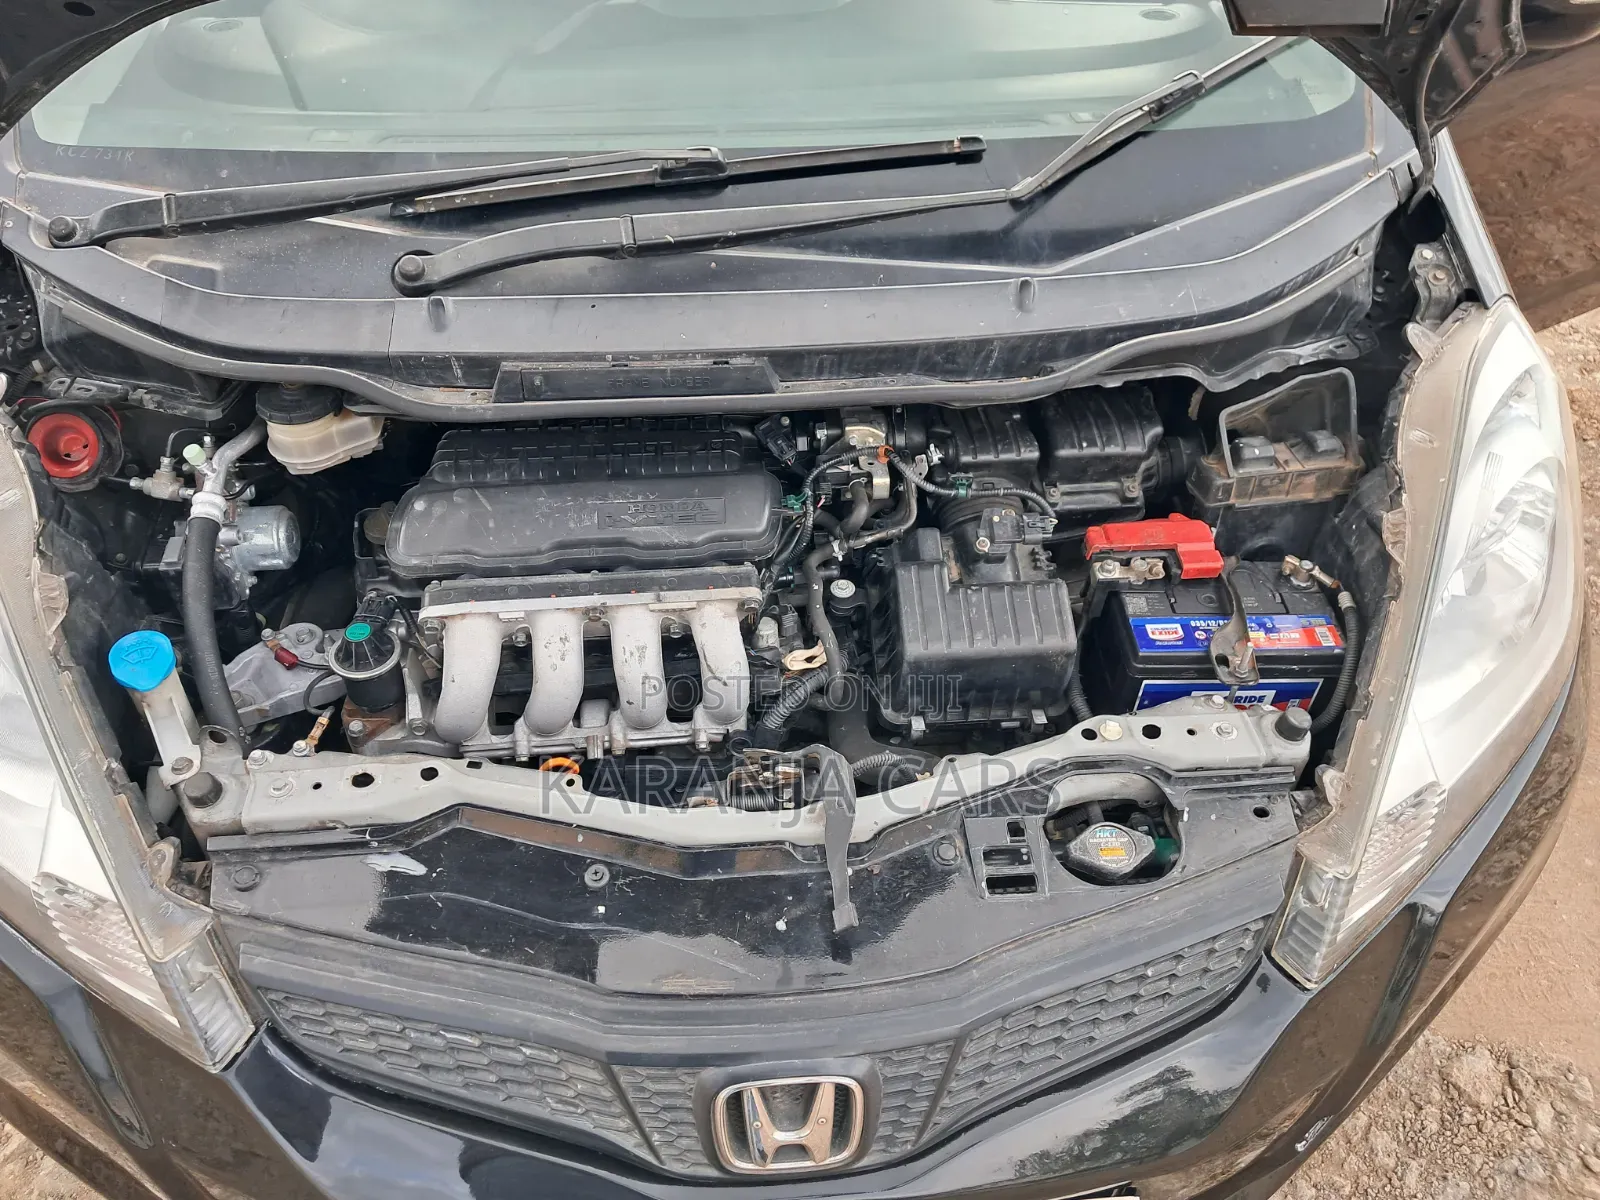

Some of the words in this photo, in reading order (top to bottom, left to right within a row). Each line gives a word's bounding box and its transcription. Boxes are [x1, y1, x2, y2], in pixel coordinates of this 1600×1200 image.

[607, 377, 650, 389] FRAME
[660, 376, 712, 388] NUMBER
[627, 500, 709, 514] HONDA
[1096, 828, 1117, 838] HKT
